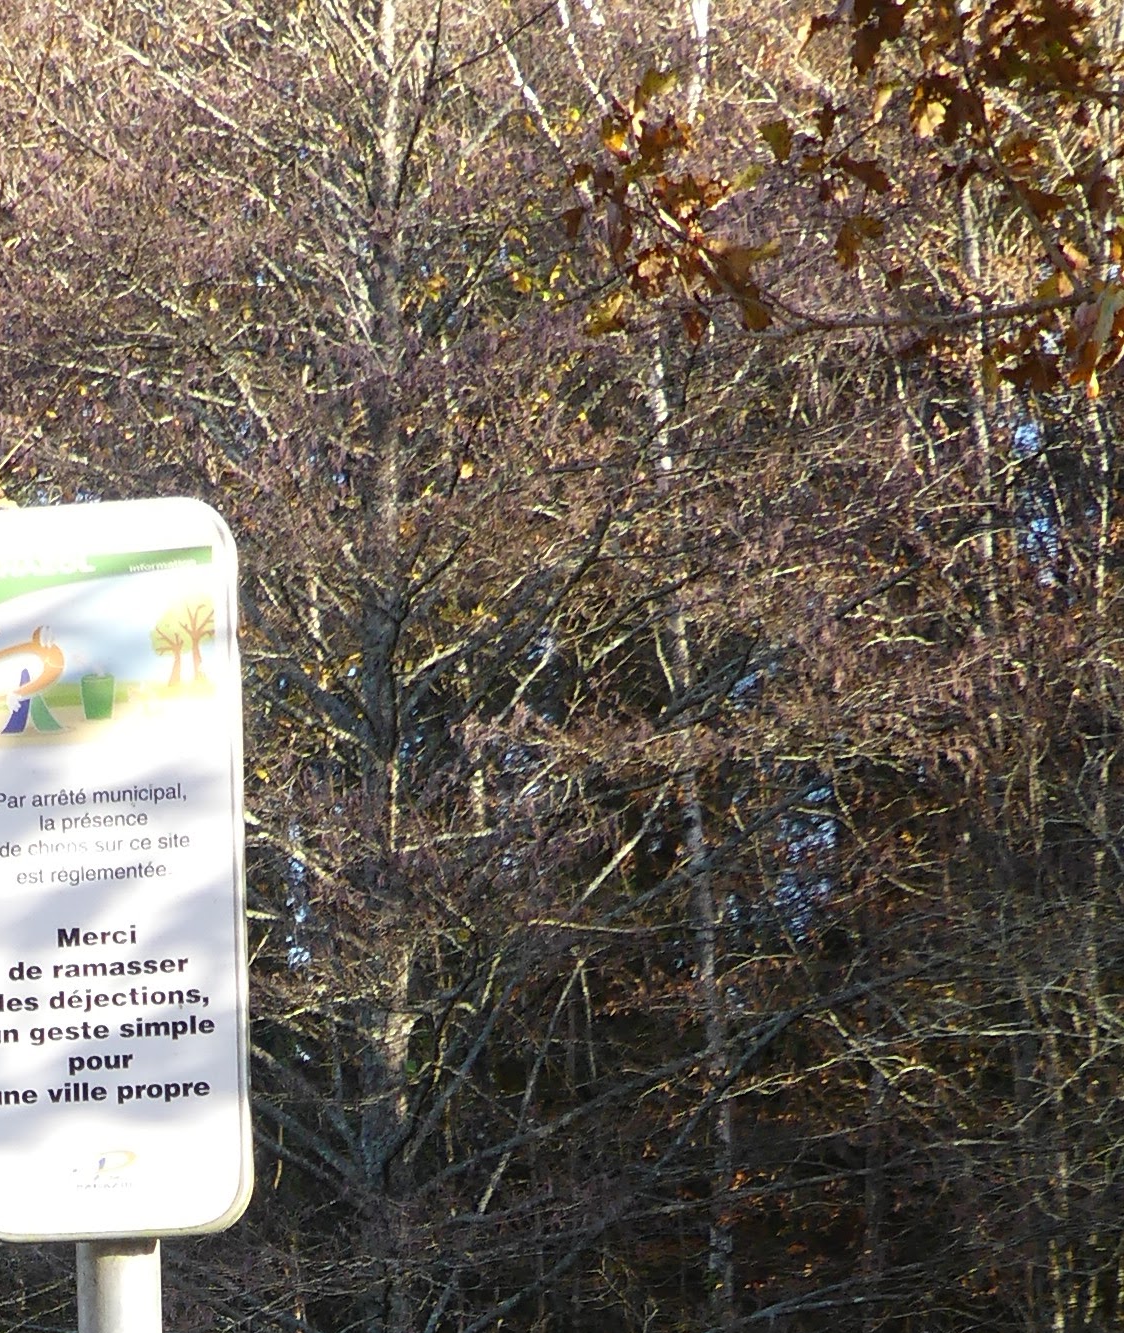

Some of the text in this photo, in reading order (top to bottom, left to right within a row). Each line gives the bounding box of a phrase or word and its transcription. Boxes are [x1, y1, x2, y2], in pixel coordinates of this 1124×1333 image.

[32, 788, 87, 807] arrêté
[92, 782, 188, 805] municipal,
[39, 811, 148, 833] la présence
[0, 832, 190, 857] de chiens sur ce site
[16, 869, 44, 885] est
[57, 924, 137, 948] Merci
[9, 956, 189, 981] de ramasser
[49, 986, 210, 1013] déjections,
[29, 1021, 109, 1045] geste
[119, 1016, 216, 1040] simple
[68, 1052, 133, 1076] pour
[47, 1082, 108, 1104] ville
[117, 1079, 210, 1104] propre
